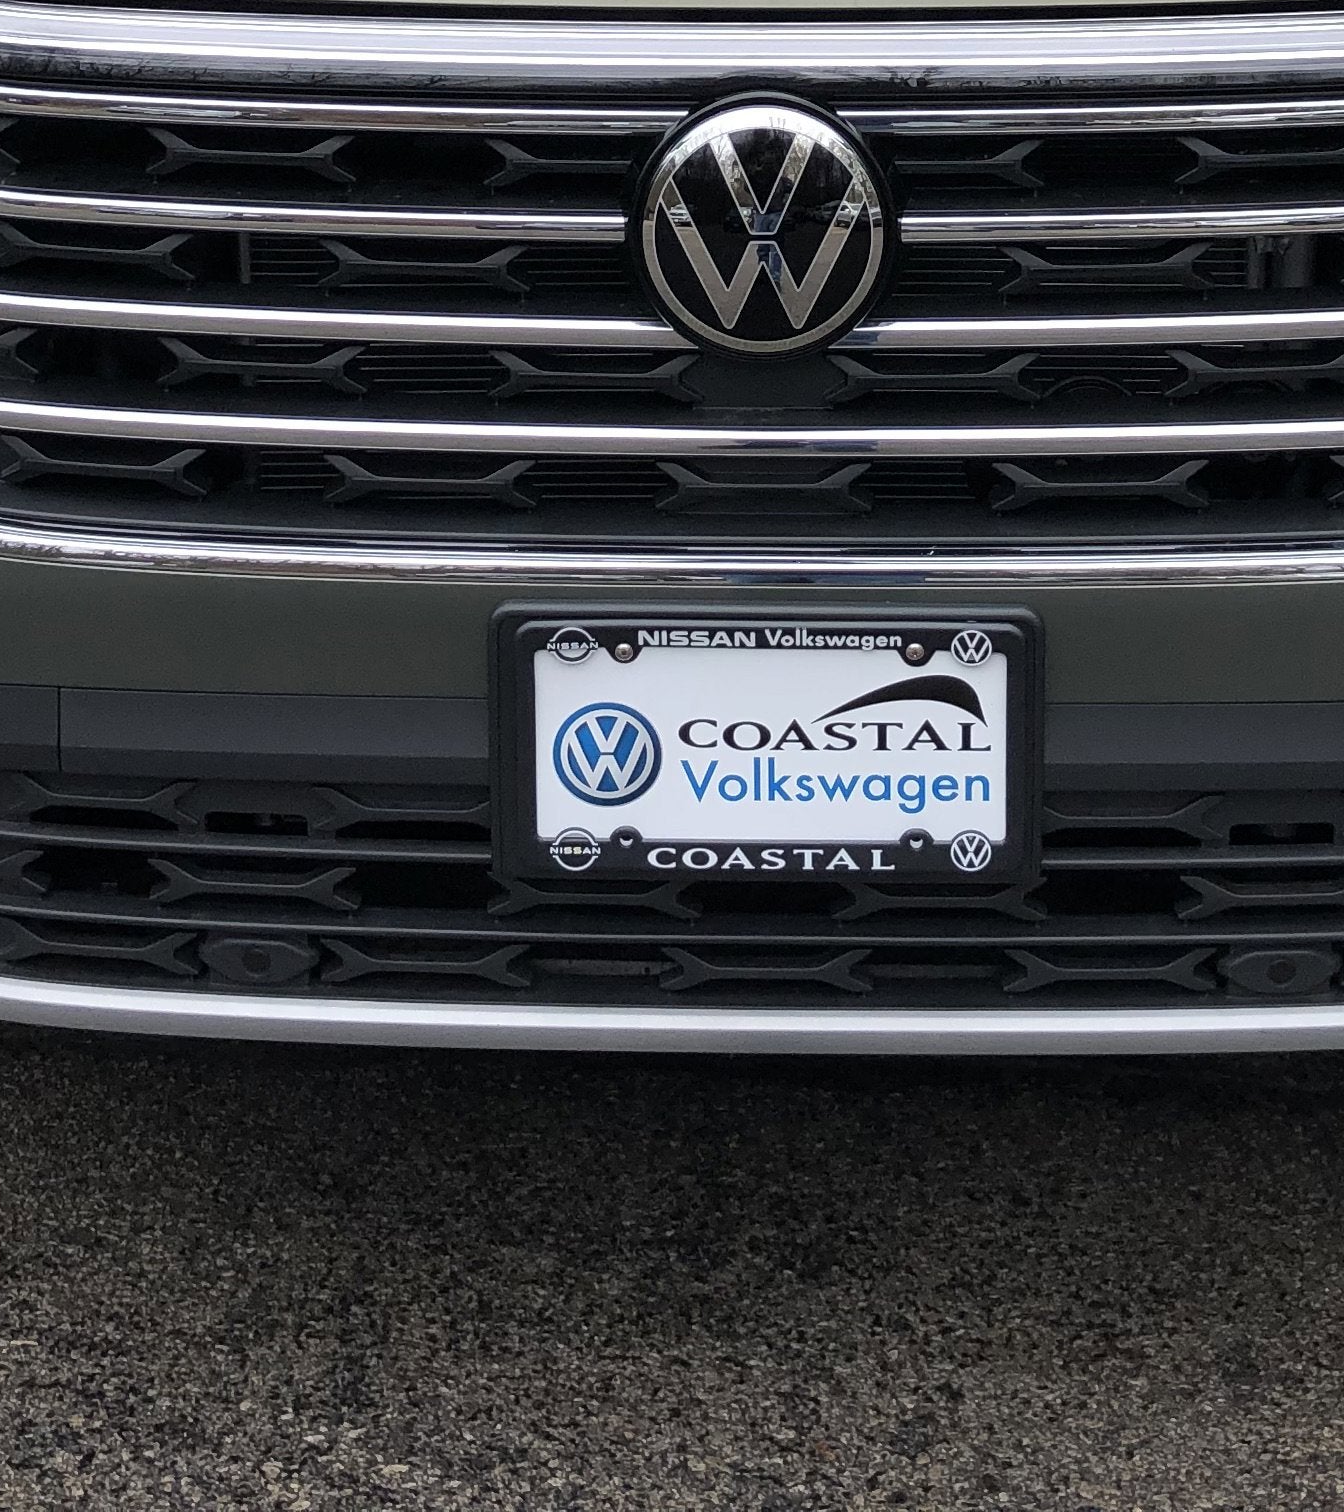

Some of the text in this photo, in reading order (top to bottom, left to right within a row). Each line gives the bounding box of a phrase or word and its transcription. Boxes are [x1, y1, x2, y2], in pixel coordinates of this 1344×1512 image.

[658, 128, 868, 332] VW
[546, 641, 599, 651] NISSAN
[637, 628, 903, 651] NISSAN Volkswagen
[678, 718, 992, 752] COASTAL
[680, 756, 991, 814] Volkswagen
[549, 845, 602, 856] NISSAN
[646, 846, 896, 871] COASTAL
